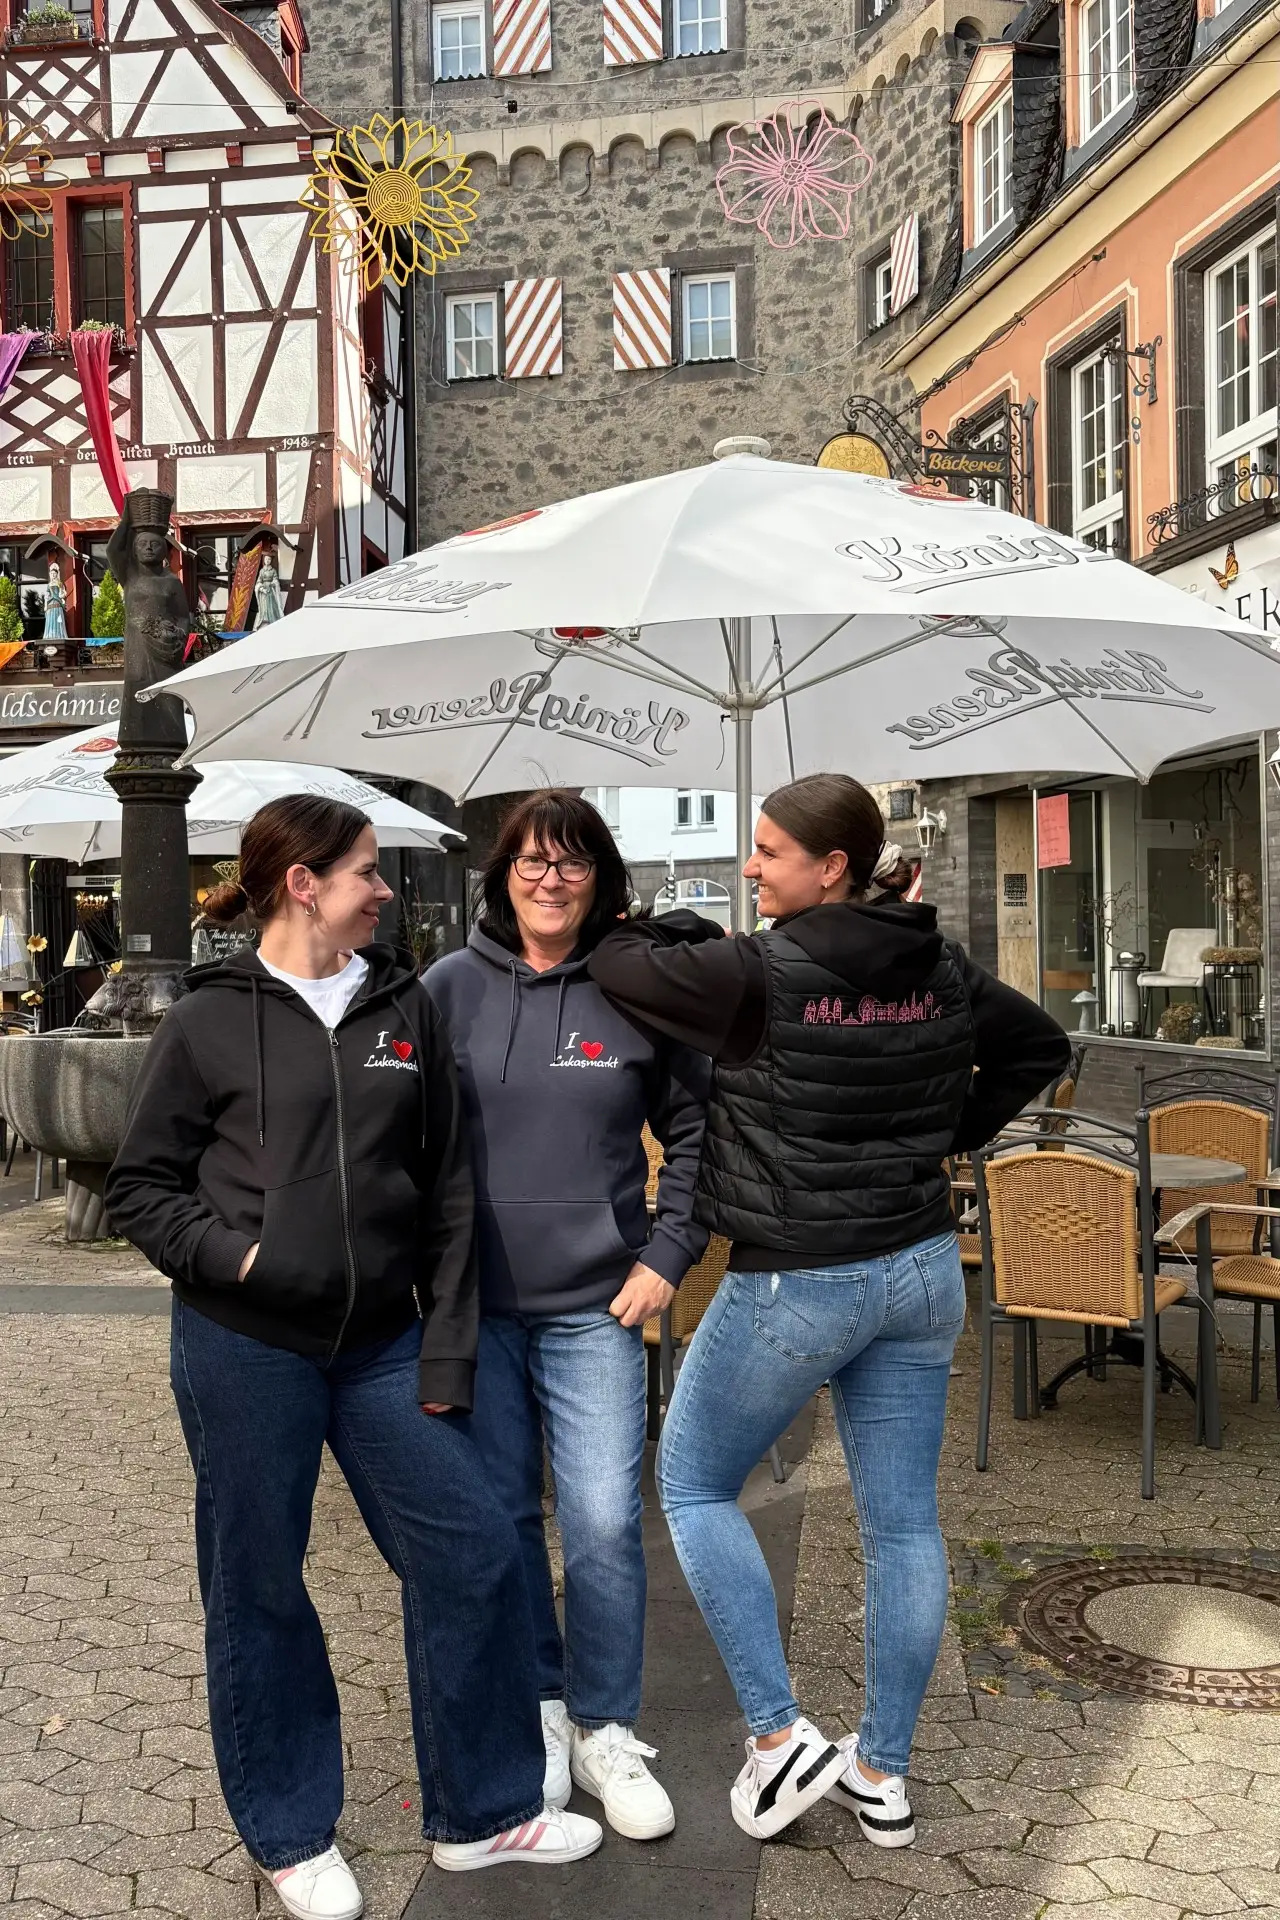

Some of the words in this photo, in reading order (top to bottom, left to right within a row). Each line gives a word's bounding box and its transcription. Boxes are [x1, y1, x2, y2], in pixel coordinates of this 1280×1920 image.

[7, 453, 35, 466] treu
[76, 449, 98, 461] den
[169, 442, 216, 456] Brauch
[281, 436, 308, 451] 1948
[928, 452, 1007, 474] Bäckerei
[835, 533, 1080, 583] König
[332, 561, 513, 604] Pilsener
[1, 690, 121, 718] ldschmie
[375, 1030, 390, 1049] I
[564, 1031, 580, 1050] I
[549, 1054, 619, 1069] Lukasmarkt
